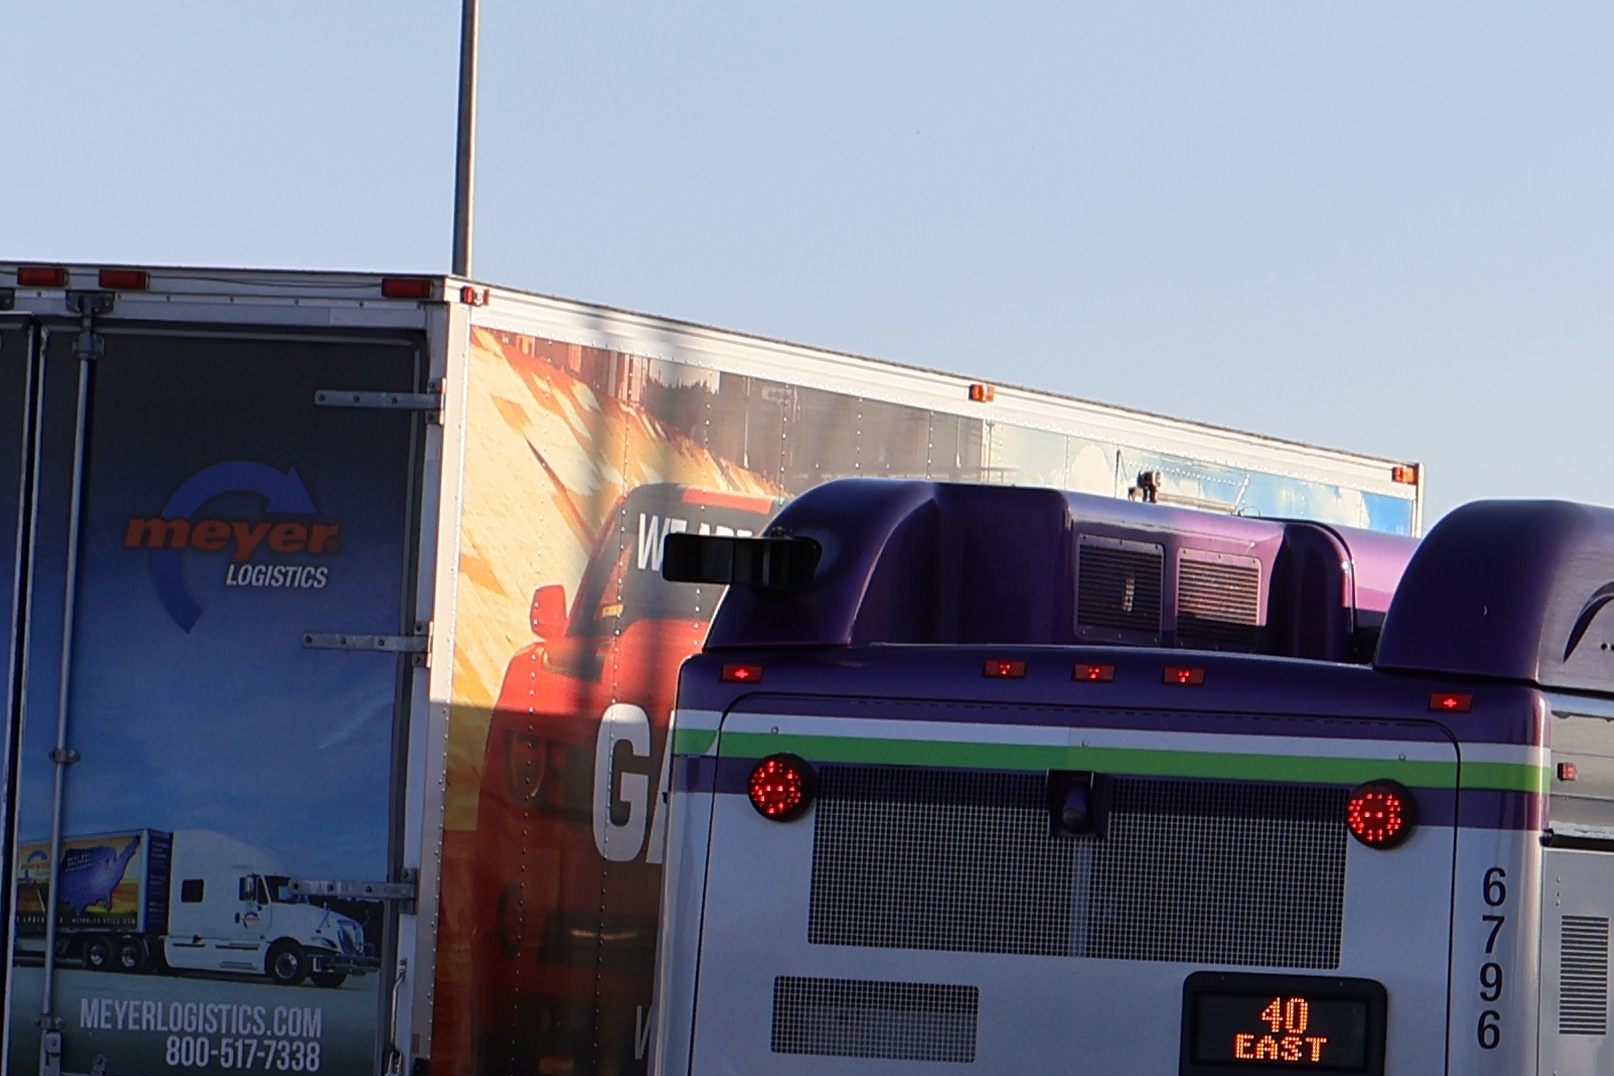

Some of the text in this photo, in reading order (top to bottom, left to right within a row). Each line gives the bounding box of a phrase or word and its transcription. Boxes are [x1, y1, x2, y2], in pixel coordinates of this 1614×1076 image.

[125, 518, 340, 561] meyer
[225, 563, 328, 588] LOGISTICS
[1477, 867, 1507, 1050] 6796
[80, 998, 322, 1038] MEYERLOGISTICS.COM
[1261, 997, 1309, 1034] 40
[165, 1036, 321, 1072] 800-517-7338
[1235, 1033, 1328, 1062] EAST
